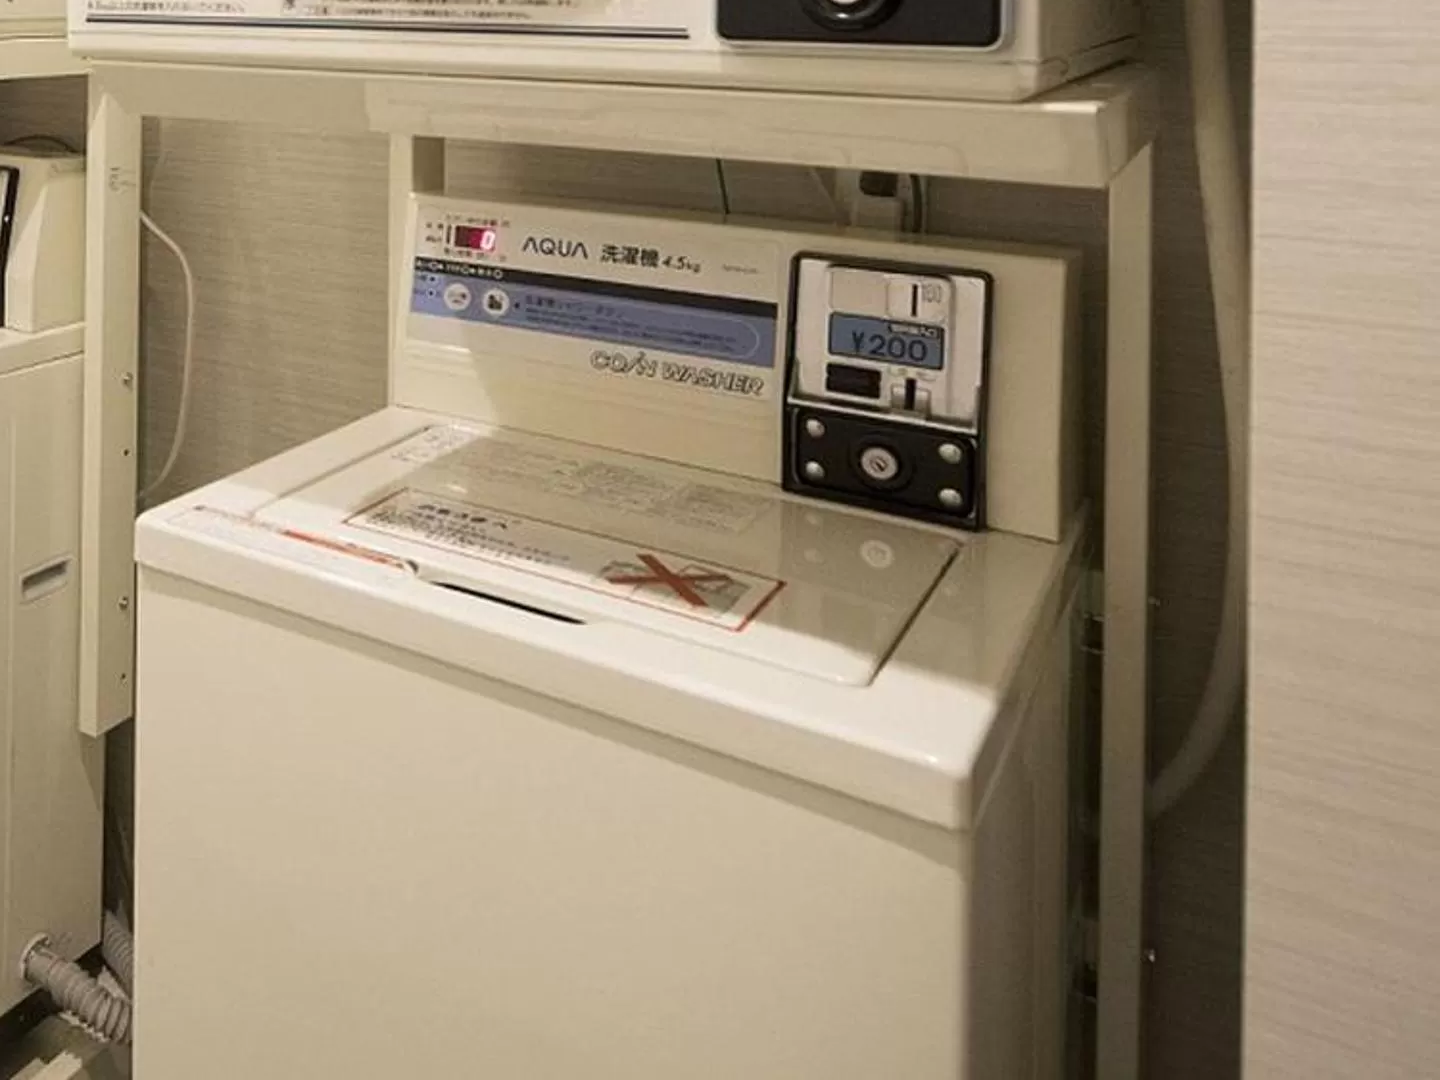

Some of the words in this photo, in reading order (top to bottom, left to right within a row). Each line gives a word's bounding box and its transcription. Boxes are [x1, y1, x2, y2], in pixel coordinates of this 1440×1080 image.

[480, 229, 497, 251] 0
[522, 236, 589, 261] AQUA
[600, 243, 660, 269] 洗濯機
[590, 350, 657, 378] COIN
[661, 360, 766, 397] WASHER
